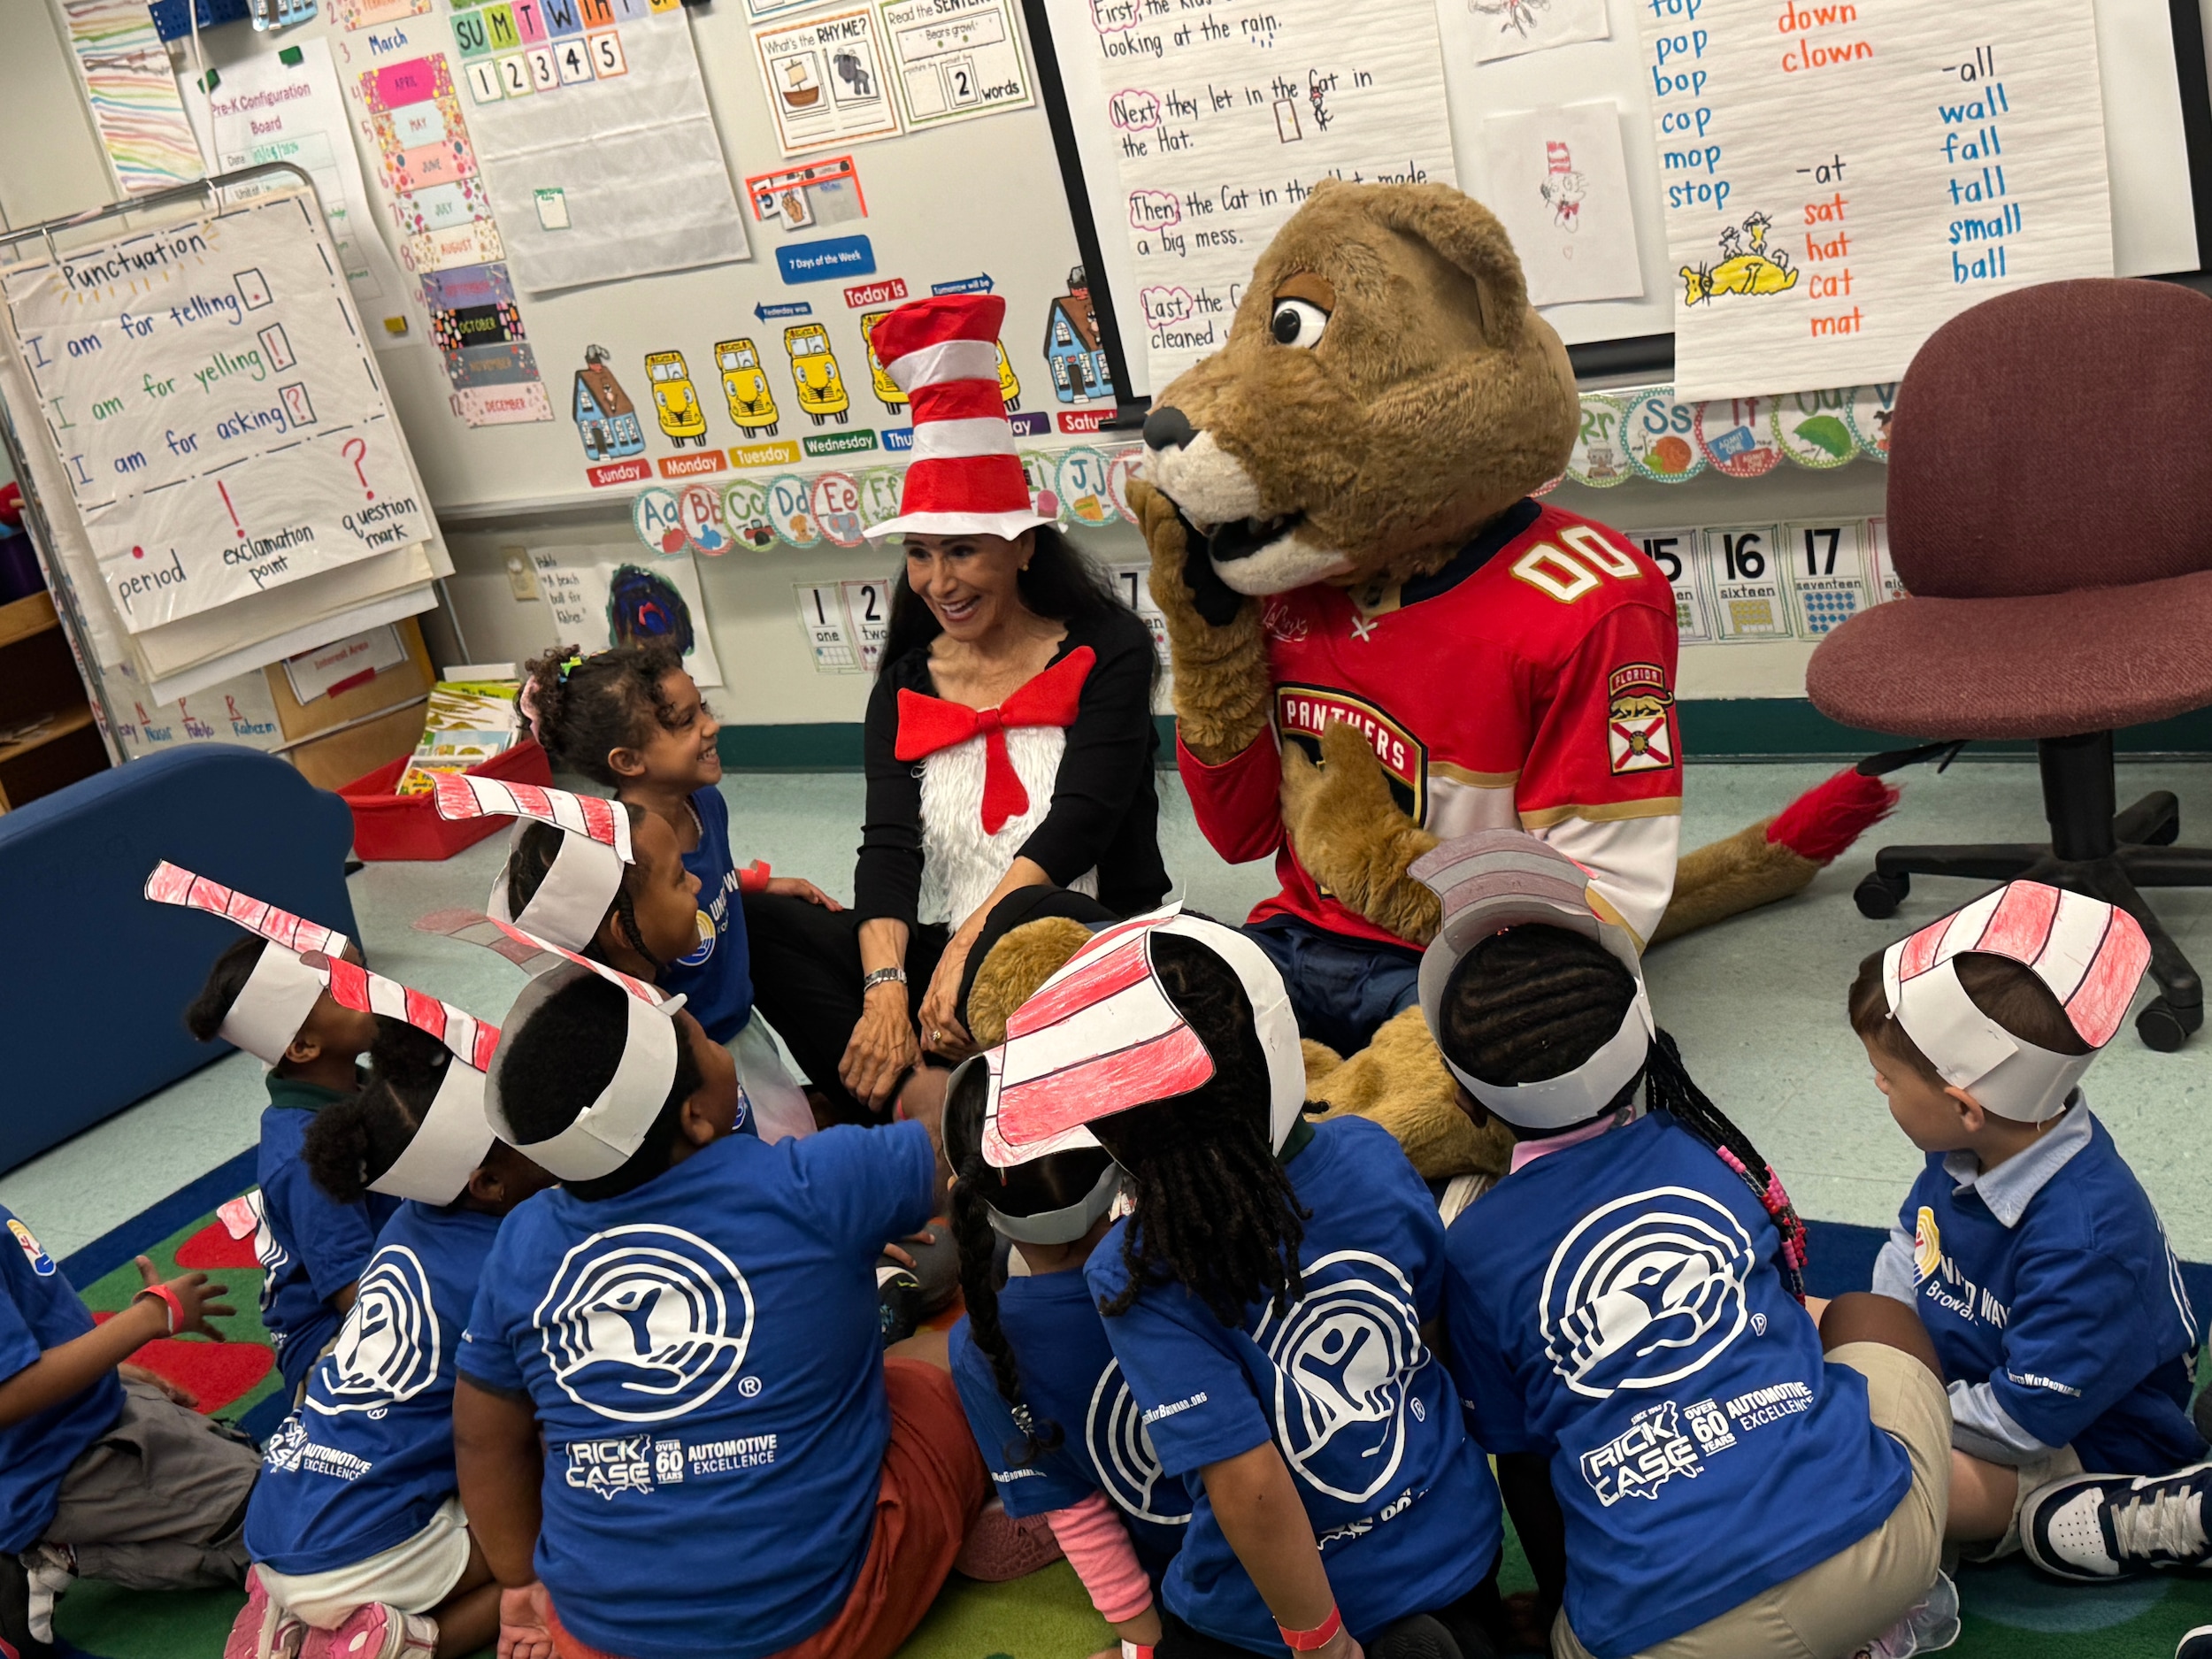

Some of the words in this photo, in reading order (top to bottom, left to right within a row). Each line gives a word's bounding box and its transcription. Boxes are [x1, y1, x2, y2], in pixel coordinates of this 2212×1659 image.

[326, 2, 337, 25] 2
[457, 19, 485, 51] SU
[492, 12, 513, 42] M
[519, 4, 534, 35] T
[546, 0, 572, 29] W
[887, 8, 915, 25] Read
[917, 5, 933, 18] the
[1778, 1, 1856, 34] down
[340, 42, 351, 63] 3
[368, 27, 408, 56] March
[764, 38, 797, 56] What's
[799, 35, 816, 47] the
[817, 18, 867, 43] RHYME?
[926, 27, 950, 40] Bears
[1100, 30, 1163, 58] looking
[1174, 24, 1191, 47] at
[1200, 14, 1230, 40] the
[1241, 14, 1282, 35] rain.
[1656, 30, 1708, 65] pop
[479, 68, 489, 95] 1
[507, 63, 525, 88] 2
[537, 55, 549, 81] 3
[566, 48, 580, 75] 4
[601, 41, 615, 68] 5
[1782, 39, 1873, 73] clown
[395, 76, 417, 88] APRIL
[956, 72, 970, 96] 2
[981, 80, 1020, 101] words
[1652, 65, 1707, 97] bop
[240, 82, 311, 111] Configuration
[1114, 97, 1161, 126] Next,
[1166, 92, 1198, 120] they
[1209, 84, 1233, 111] let
[1246, 87, 1263, 105] in
[1271, 75, 1298, 99] the
[1354, 67, 1372, 88] in
[1938, 83, 2008, 124] wall
[250, 117, 281, 136] Board
[361, 120, 373, 142] 5
[410, 117, 427, 132] MAY
[1662, 107, 1711, 137] cop
[1122, 136, 1148, 158] the
[1157, 127, 1194, 152] Hat.
[1939, 126, 2001, 164] fall
[422, 160, 442, 173] JUNE
[1663, 145, 1721, 174] mop
[1669, 180, 1731, 211] stop
[1947, 165, 2006, 205] tall
[434, 202, 453, 216] JULY
[1131, 196, 1180, 221] Then,
[1186, 192, 1213, 217] the
[1221, 185, 1248, 211] Cat
[1259, 188, 1278, 206] in
[1804, 194, 1848, 226] sat
[1948, 203, 2022, 245] small
[400, 245, 415, 272] 8
[441, 239, 472, 256] AUGUST
[1137, 240, 1150, 255] a
[1161, 227, 1186, 257] big
[1196, 229, 1244, 248] mess.
[1806, 232, 1852, 262] hat
[63, 234, 207, 291] Punctuation
[796, 257, 814, 269] Days
[815, 255, 823, 265] of
[824, 255, 838, 265] the
[838, 250, 862, 263] Week
[1952, 246, 2007, 284] ball
[846, 286, 890, 307] Today
[891, 281, 905, 297] is
[967, 280, 980, 289] will
[980, 279, 990, 288] be
[1809, 269, 1854, 299] cat
[1143, 294, 1189, 319] Last,
[1194, 287, 1223, 313] the
[26, 336, 52, 368] I
[67, 334, 103, 358] am
[120, 313, 154, 340] for
[170, 295, 242, 327] telling
[458, 317, 497, 334] OCTOBER
[1151, 319, 1214, 349] cleaned
[1810, 306, 1865, 337] mat
[50, 396, 76, 429] I
[91, 396, 125, 420] am
[142, 373, 176, 398] for
[194, 350, 266, 395] yelling
[484, 398, 526, 413] DECEMBER
[1643, 398, 1692, 434] Ss
[70, 454, 94, 485] I
[113, 451, 147, 473] am
[165, 429, 198, 456] for
[217, 407, 287, 440] asking
[737, 447, 789, 466] Tuesday
[807, 434, 874, 454] Wednesday
[1718, 433, 1743, 450] ADMIT
[1726, 442, 1744, 455] ONE
[596, 465, 641, 483] Sunday
[667, 457, 718, 475] Monday
[1070, 458, 1106, 496] Jj
[342, 496, 418, 540] question
[644, 497, 679, 530] Aa
[728, 491, 765, 521] Cc
[775, 484, 810, 517] Dd
[823, 481, 858, 512] Ee
[869, 476, 898, 507] Ff
[223, 524, 315, 566] exclamation
[365, 523, 409, 549] mark
[1509, 525, 1642, 603] 00
[1724, 533, 1765, 580] 16
[1804, 528, 1840, 575] 17
[119, 548, 187, 616] period
[249, 556, 288, 591] point
[1720, 583, 1776, 600] sixteen
[1796, 577, 1862, 592] seventeen
[813, 589, 825, 625] 1
[861, 585, 881, 621] 2
[817, 630, 841, 642] one
[862, 625, 887, 640] two
[1615, 669, 1658, 687] FLORIDA
[1685, 1401, 1717, 1419] OVER
[1726, 1381, 1812, 1419] AUTOMOTIVE
[1691, 1411, 1730, 1441] 60
[572, 1439, 641, 1466] RICK
[656, 1442, 680, 1452] OVER
[688, 1434, 778, 1462] AUTOMOTIVE
[1590, 1413, 1674, 1478] RICK
[1701, 1432, 1736, 1454] YEARS
[303, 1442, 373, 1475] AUTOMOTIVE
[656, 1451, 683, 1473] 60
[694, 1451, 775, 1476] EXCELLENCE
[1595, 1435, 1699, 1508] CASE
[566, 1461, 651, 1489] CASE
